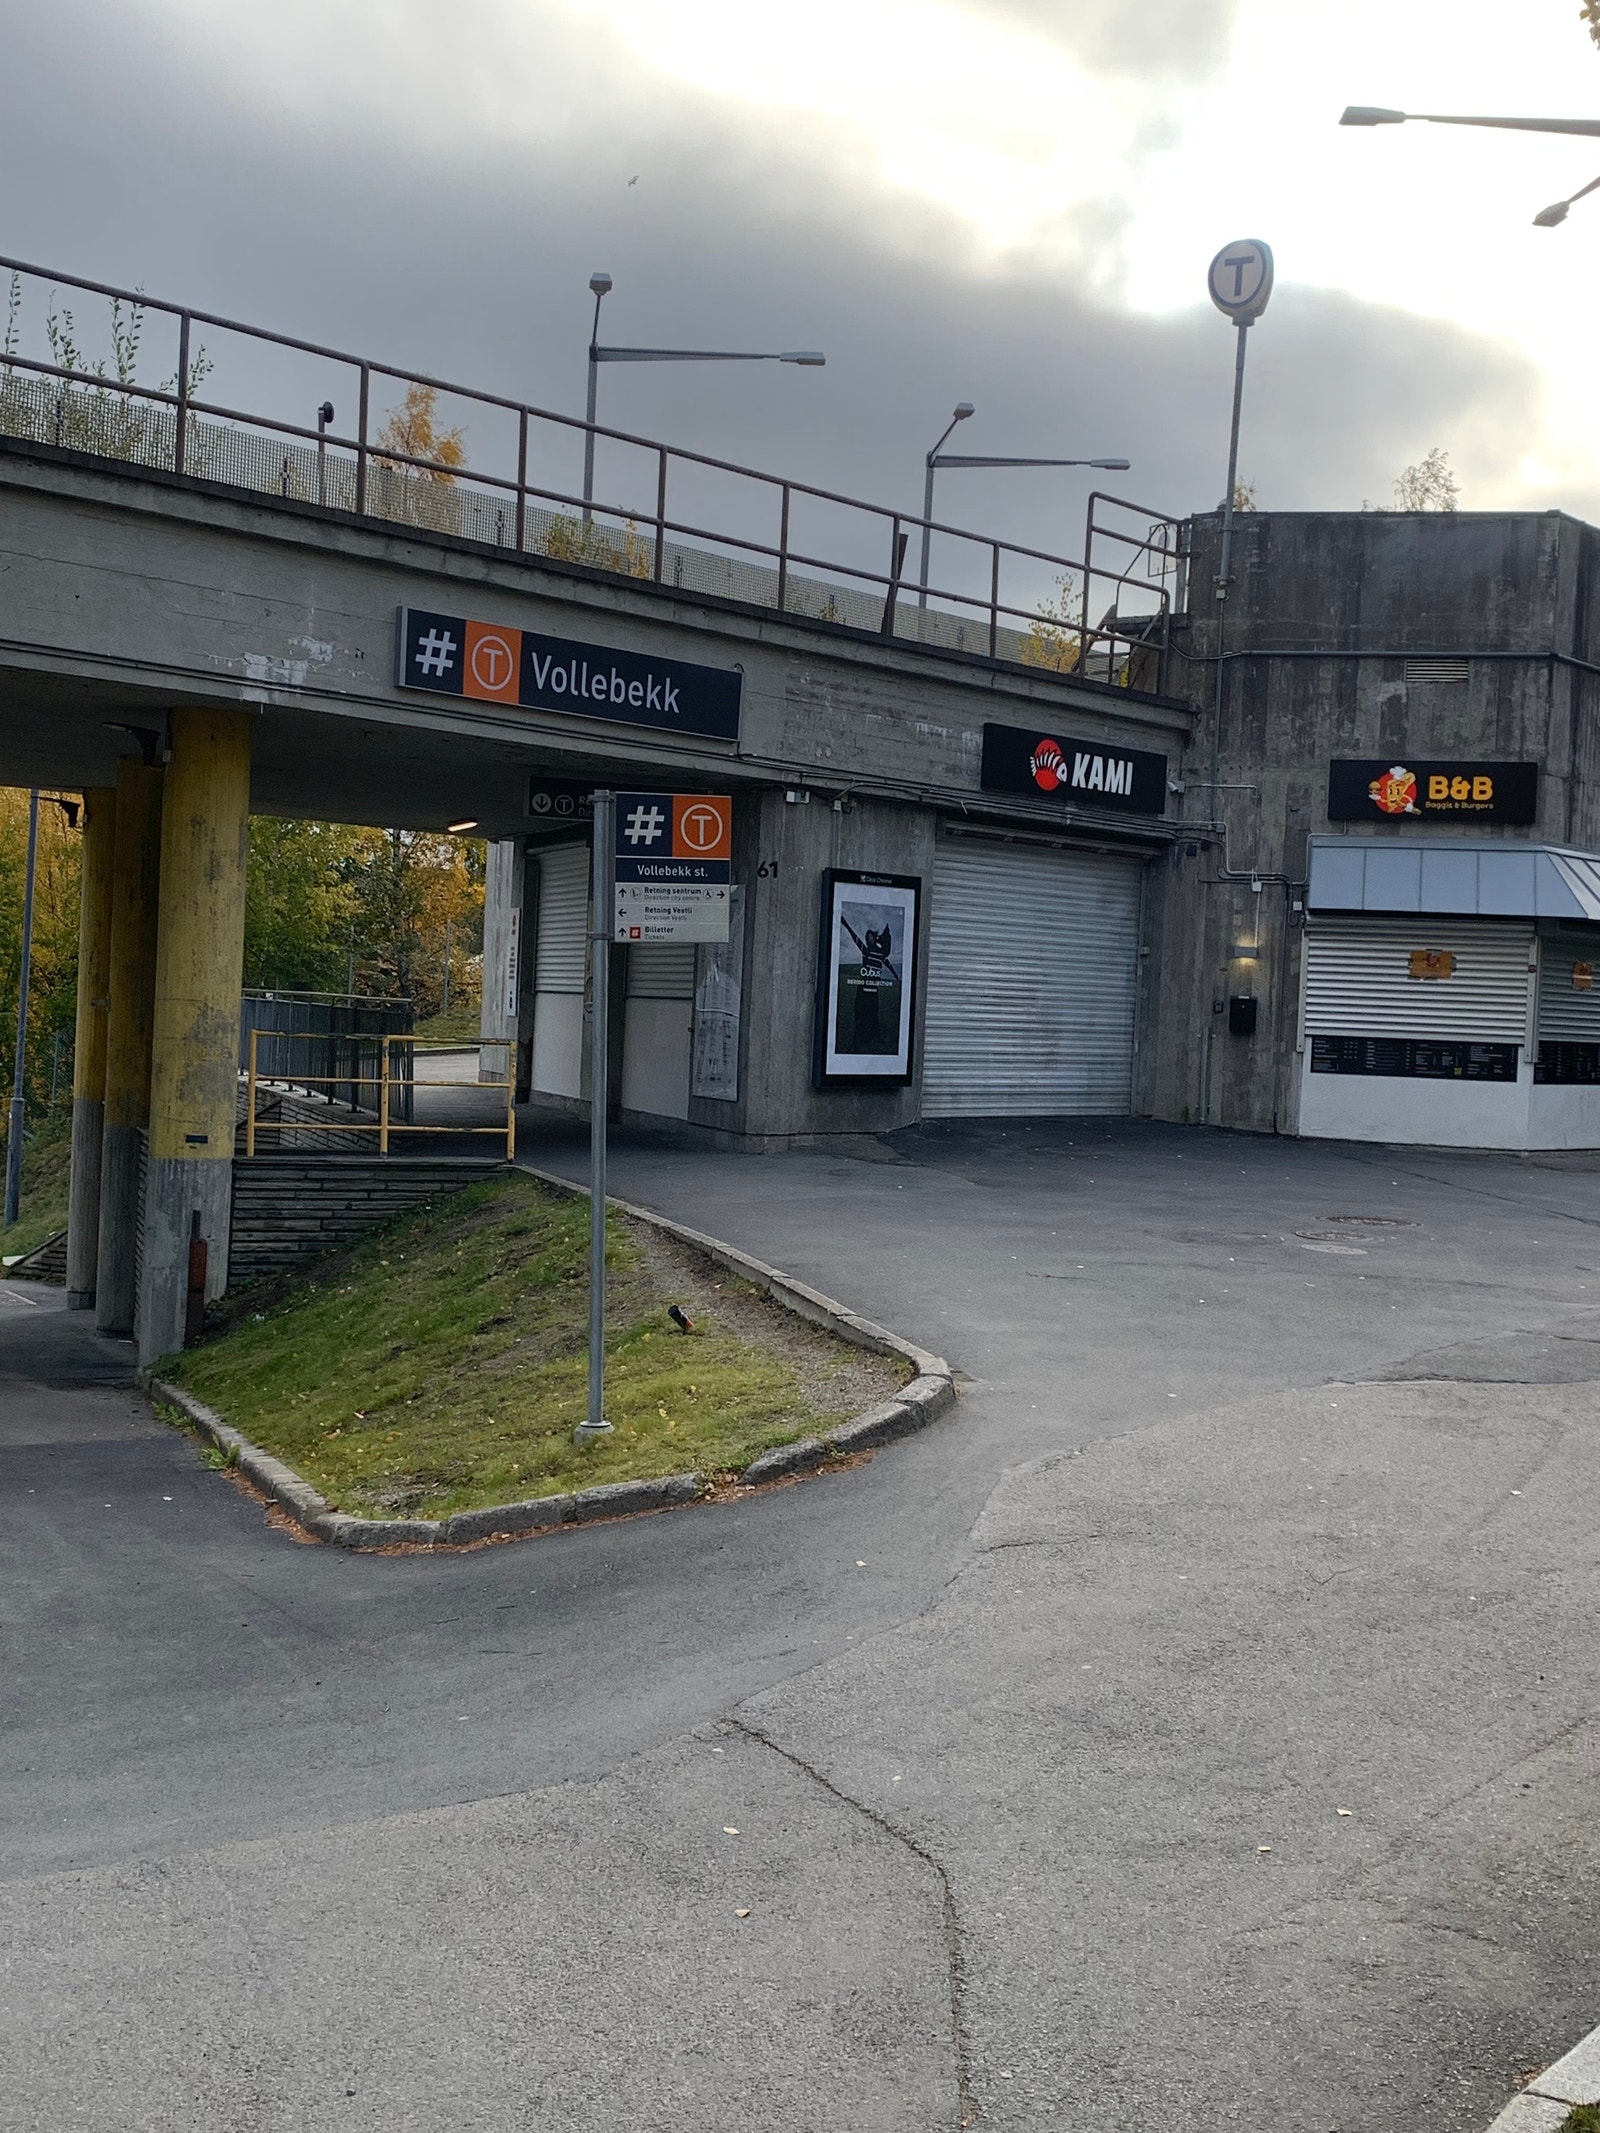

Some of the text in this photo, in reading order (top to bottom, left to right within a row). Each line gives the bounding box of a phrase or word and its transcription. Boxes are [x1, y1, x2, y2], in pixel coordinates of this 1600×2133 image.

[1224, 255, 1255, 297] T
[531, 651, 681, 714] Vollebekk
[1070, 752, 1134, 796] KAMI
[1428, 774, 1494, 801] B&B
[1461, 802, 1494, 810] Burgers
[637, 864, 709, 877] Vollebekk st.
[757, 860, 778, 878] 61
[644, 887, 702, 895] Retning sentrum
[860, 967, 881, 977] Cubus
